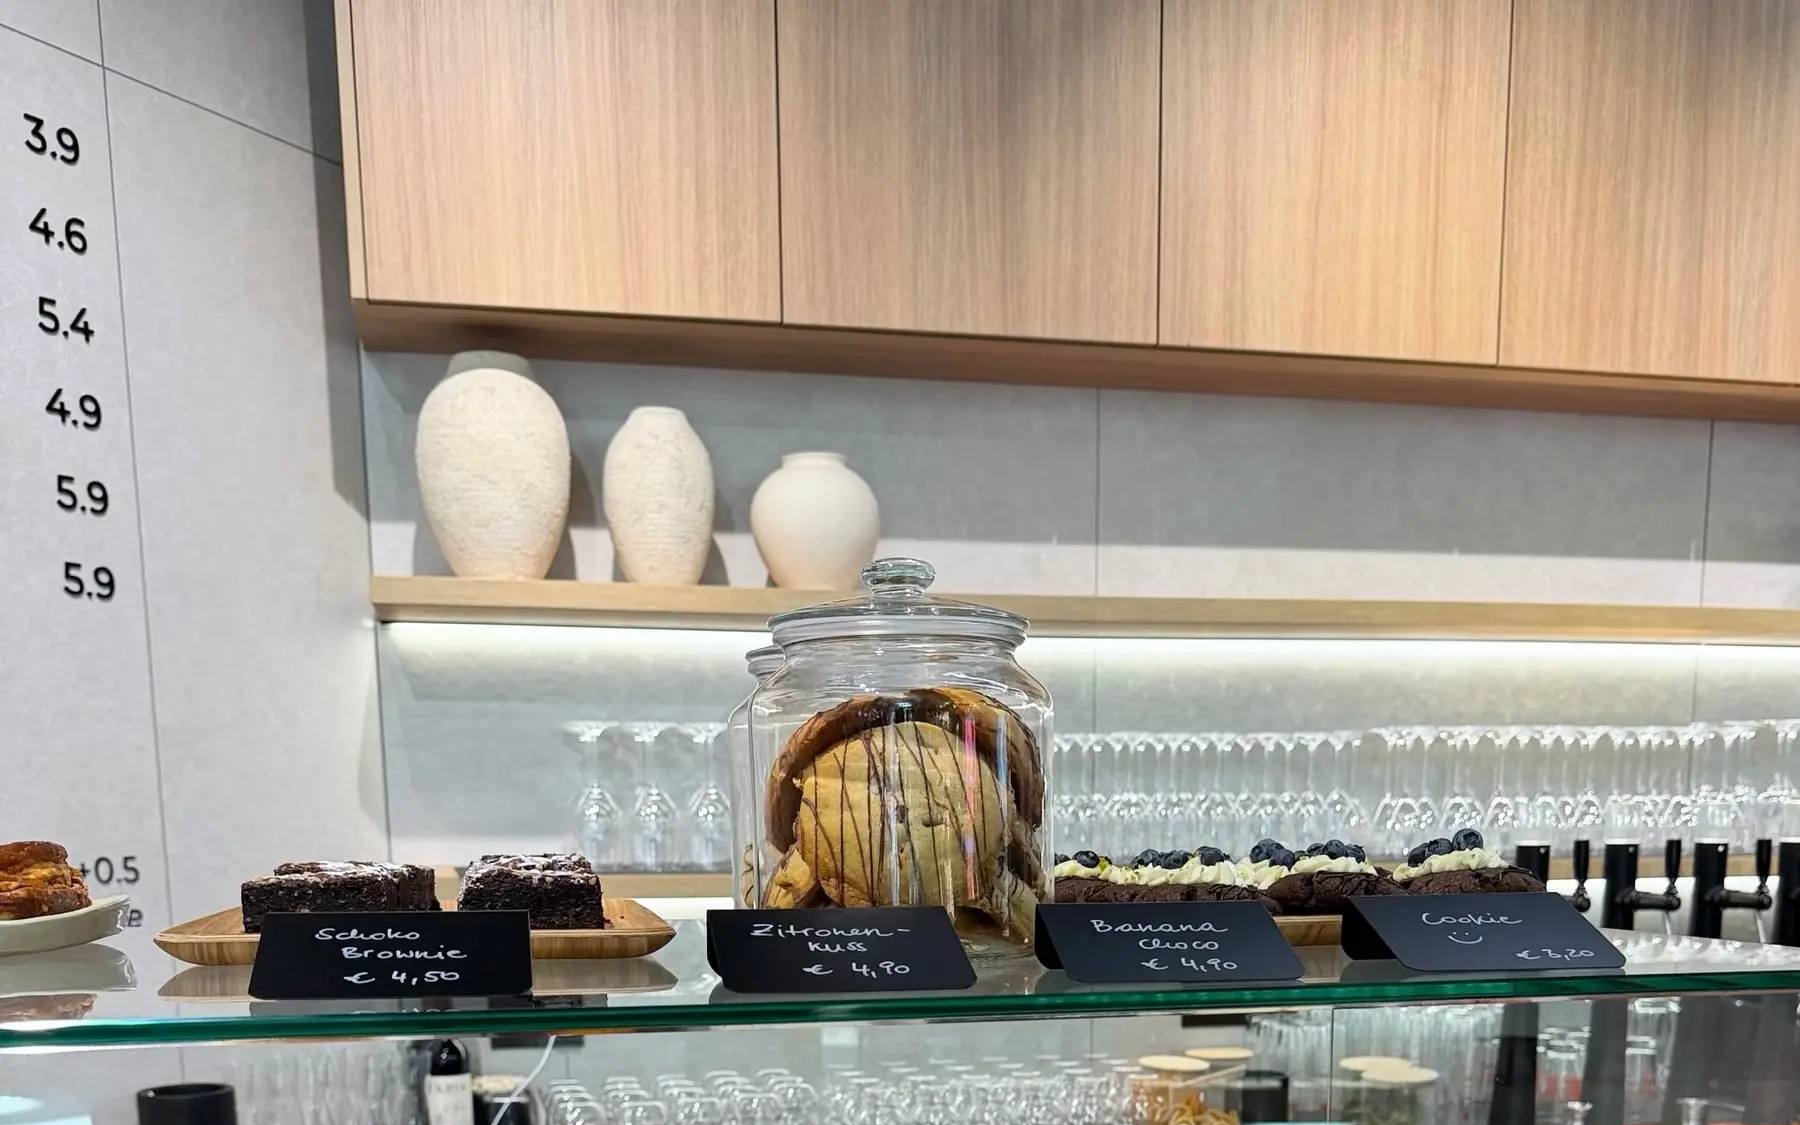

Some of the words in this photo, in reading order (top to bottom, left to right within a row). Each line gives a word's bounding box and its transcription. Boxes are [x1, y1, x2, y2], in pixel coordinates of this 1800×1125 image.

[23, 113, 80, 165] 3.9
[29, 207, 88, 256] 4.6
[37, 296, 95, 343] 5.4
[45, 387, 102, 431] 4.9
[56, 475, 110, 517] 5.9
[63, 561, 116, 602] 5.9
[1090, 918, 1228, 933] Banana
[1421, 912, 1522, 926] Cookie
[314, 927, 420, 941] Schoko
[341, 944, 468, 960] Brownie
[851, 960, 911, 979] 4,90
[1180, 956, 1239, 973] 4,90
[391, 970, 460, 986] 4,50
